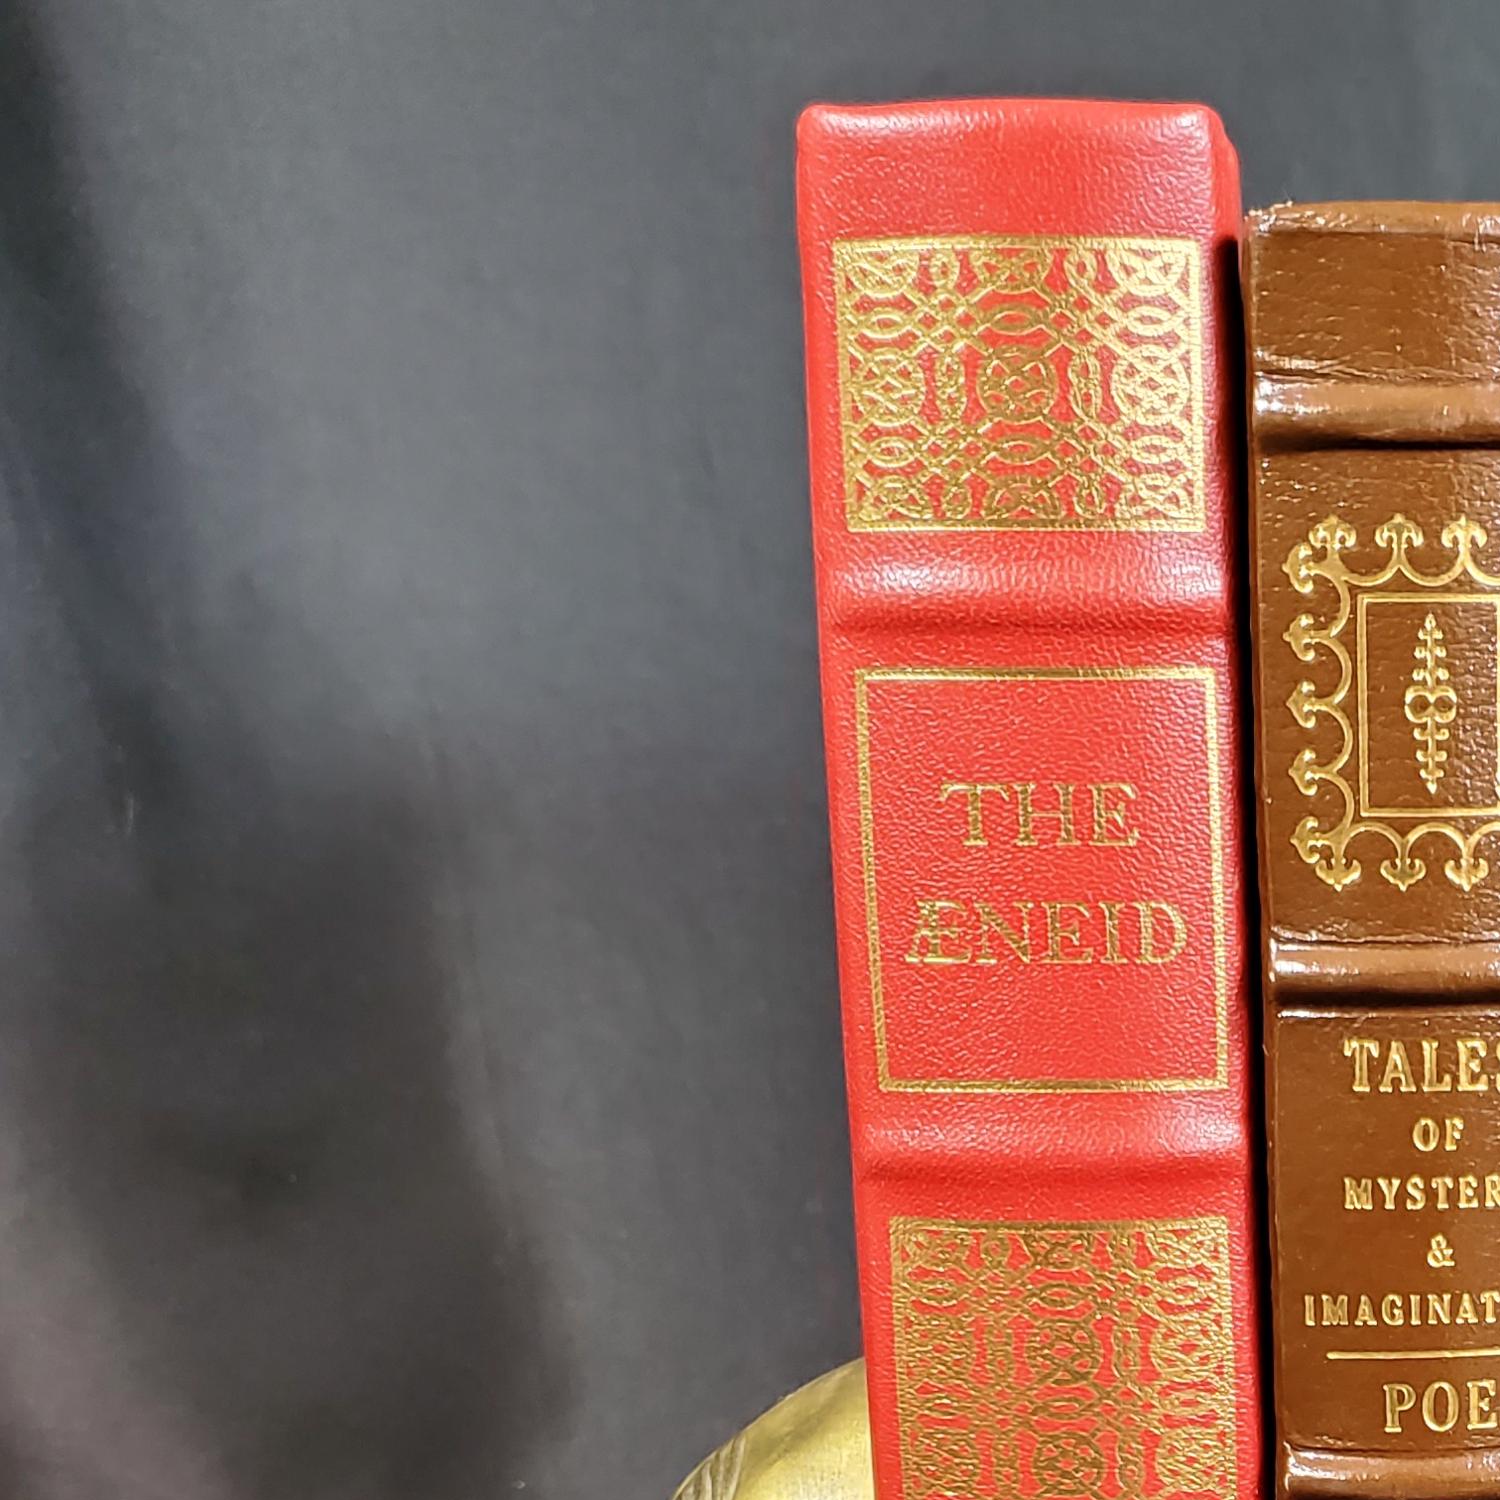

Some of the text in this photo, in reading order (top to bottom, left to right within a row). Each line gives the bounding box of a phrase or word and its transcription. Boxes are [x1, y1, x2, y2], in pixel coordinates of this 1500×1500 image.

[938, 783, 1140, 847] THE
[905, 900, 1189, 965] ÆNEID
[1413, 1117, 1464, 1152] OF
[1427, 1232, 1455, 1268] &
[1383, 1379, 1499, 1433] POE
